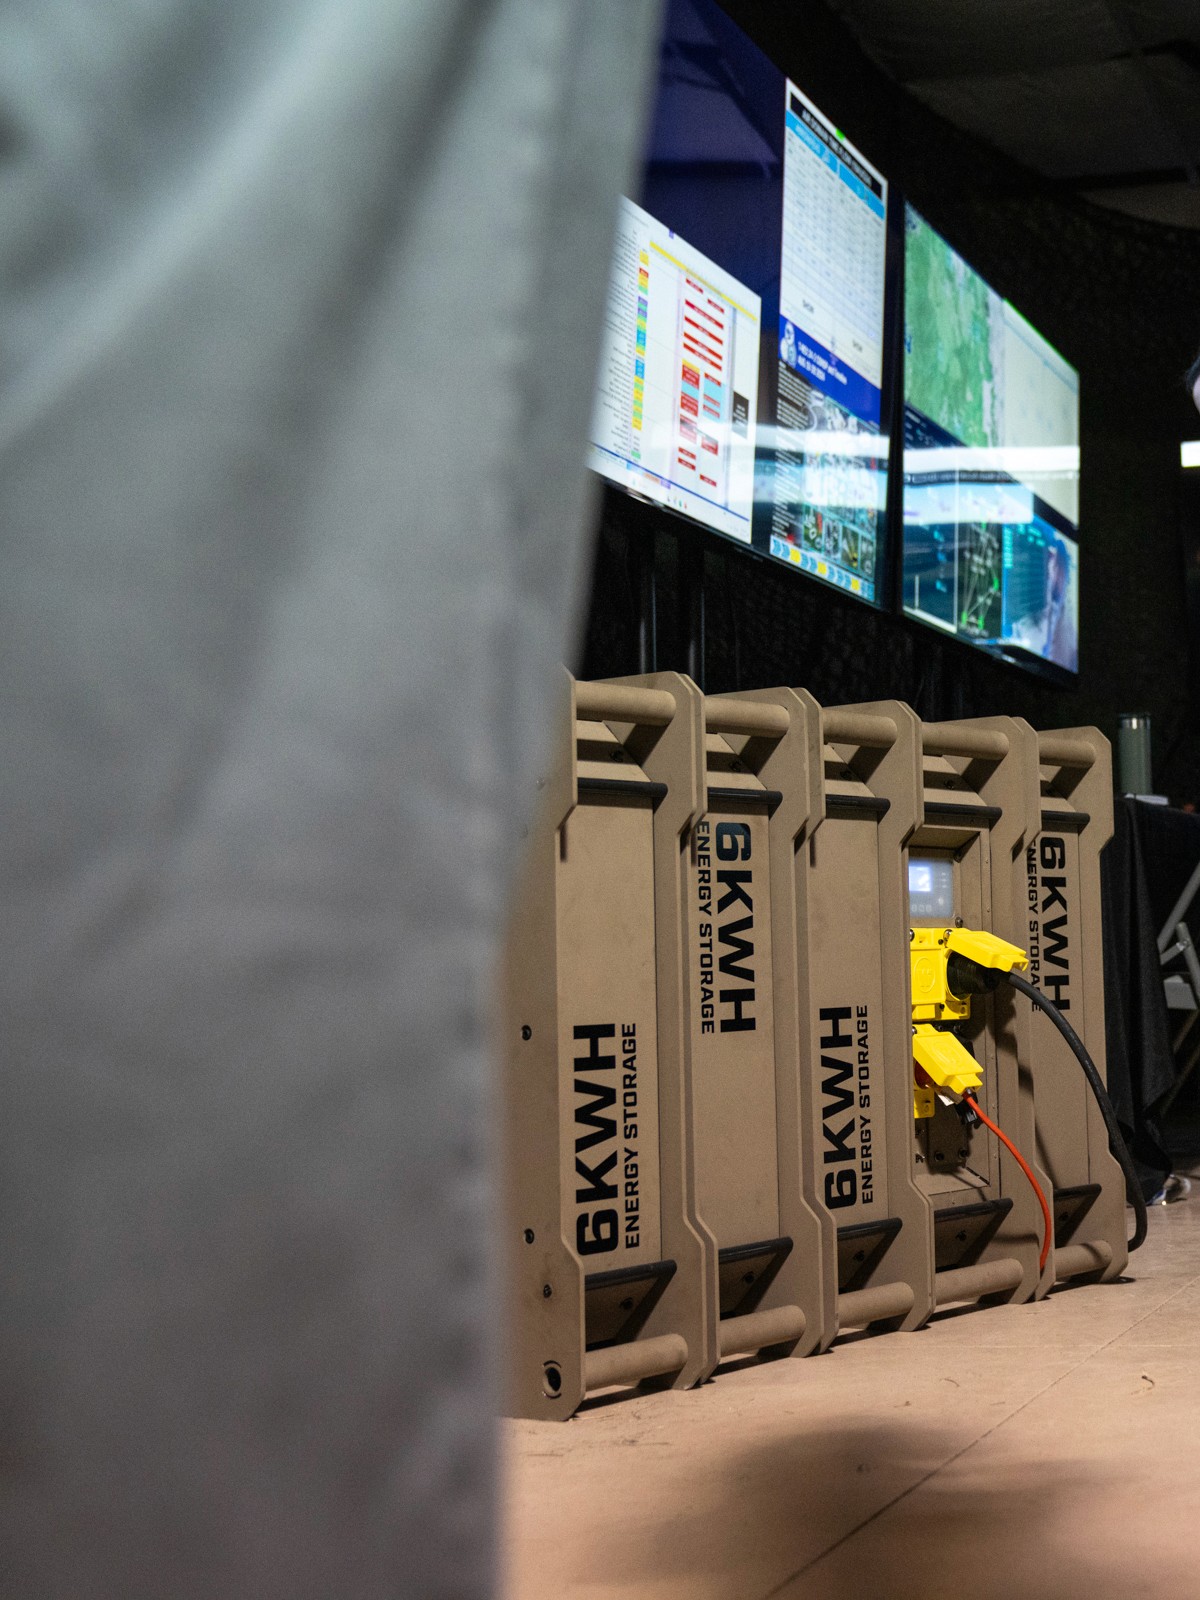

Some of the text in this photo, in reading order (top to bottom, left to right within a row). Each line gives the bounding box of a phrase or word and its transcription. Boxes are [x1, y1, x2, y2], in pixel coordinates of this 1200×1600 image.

[696, 821, 715, 1035] ENERGY STORAGE
[715, 822, 756, 1033] 6KWH
[1029, 920, 1042, 1013] STORAE
[1040, 836, 1071, 1011] 6KWH
[573, 1023, 619, 1256] 6KWH
[621, 1023, 640, 1249] ENERGY STORAGE
[819, 1006, 857, 1210] 6KWH
[856, 1005, 874, 1205] ENERGY STORAGE
